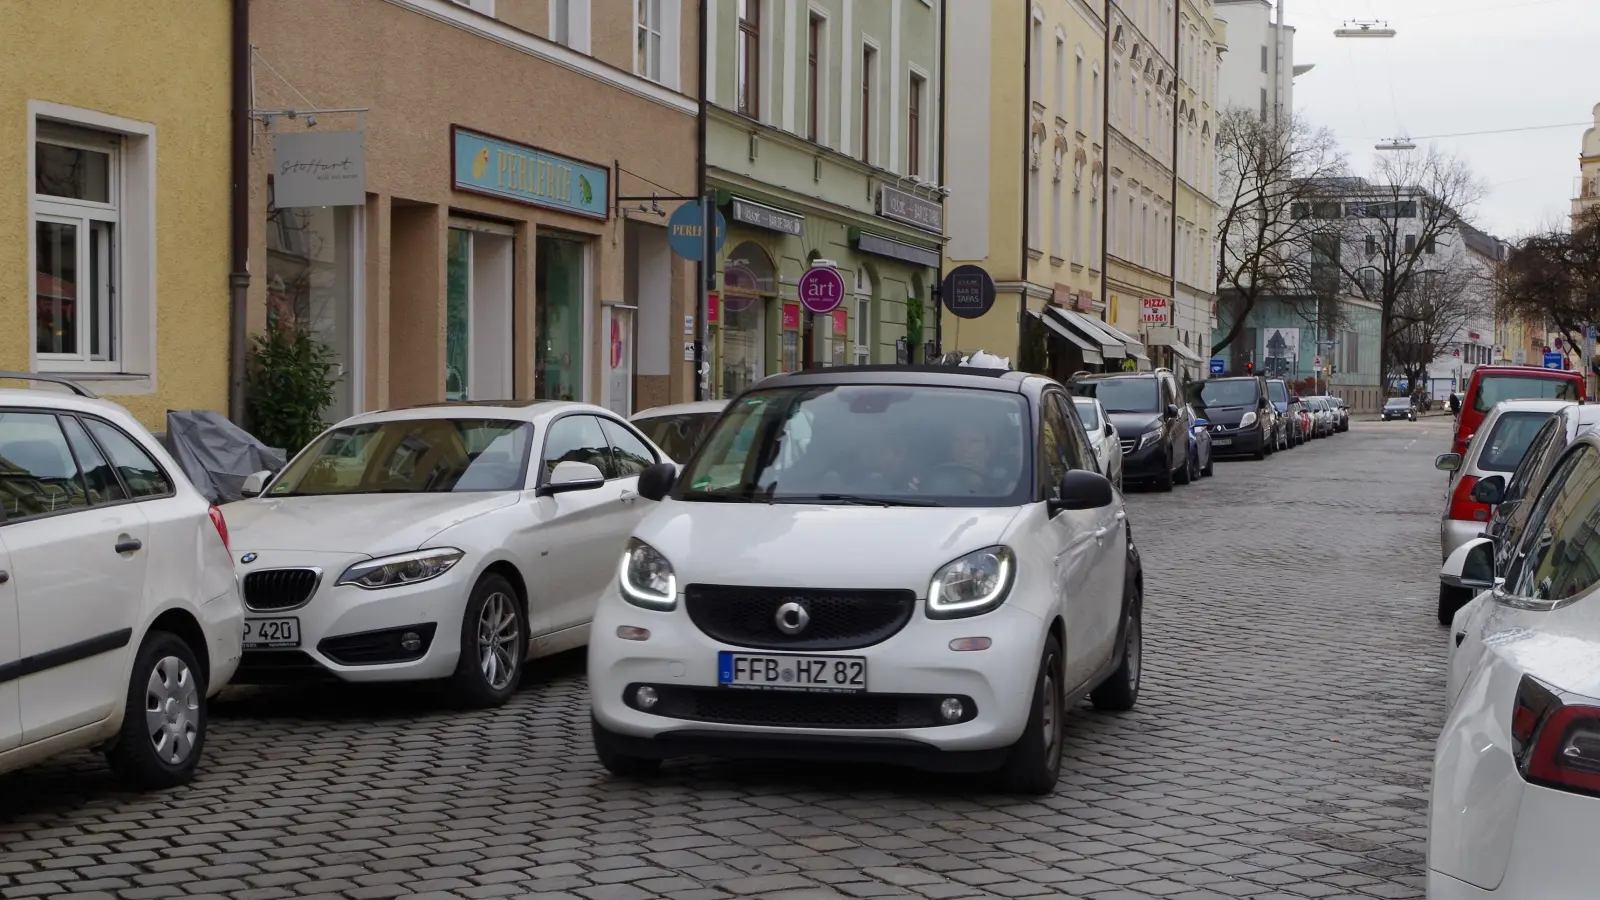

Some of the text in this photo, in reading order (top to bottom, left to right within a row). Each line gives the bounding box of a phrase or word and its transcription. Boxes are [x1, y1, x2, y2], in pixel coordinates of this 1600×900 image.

[496, 150, 573, 203] PERLERIE
[808, 281, 835, 297] art
[957, 295, 980, 303] TAPAS
[1143, 298, 1167, 308] PIZZA
[1143, 314, 1167, 322] 161561
[258, 621, 292, 640] 420
[734, 657, 864, 685] FFB HZ 82
